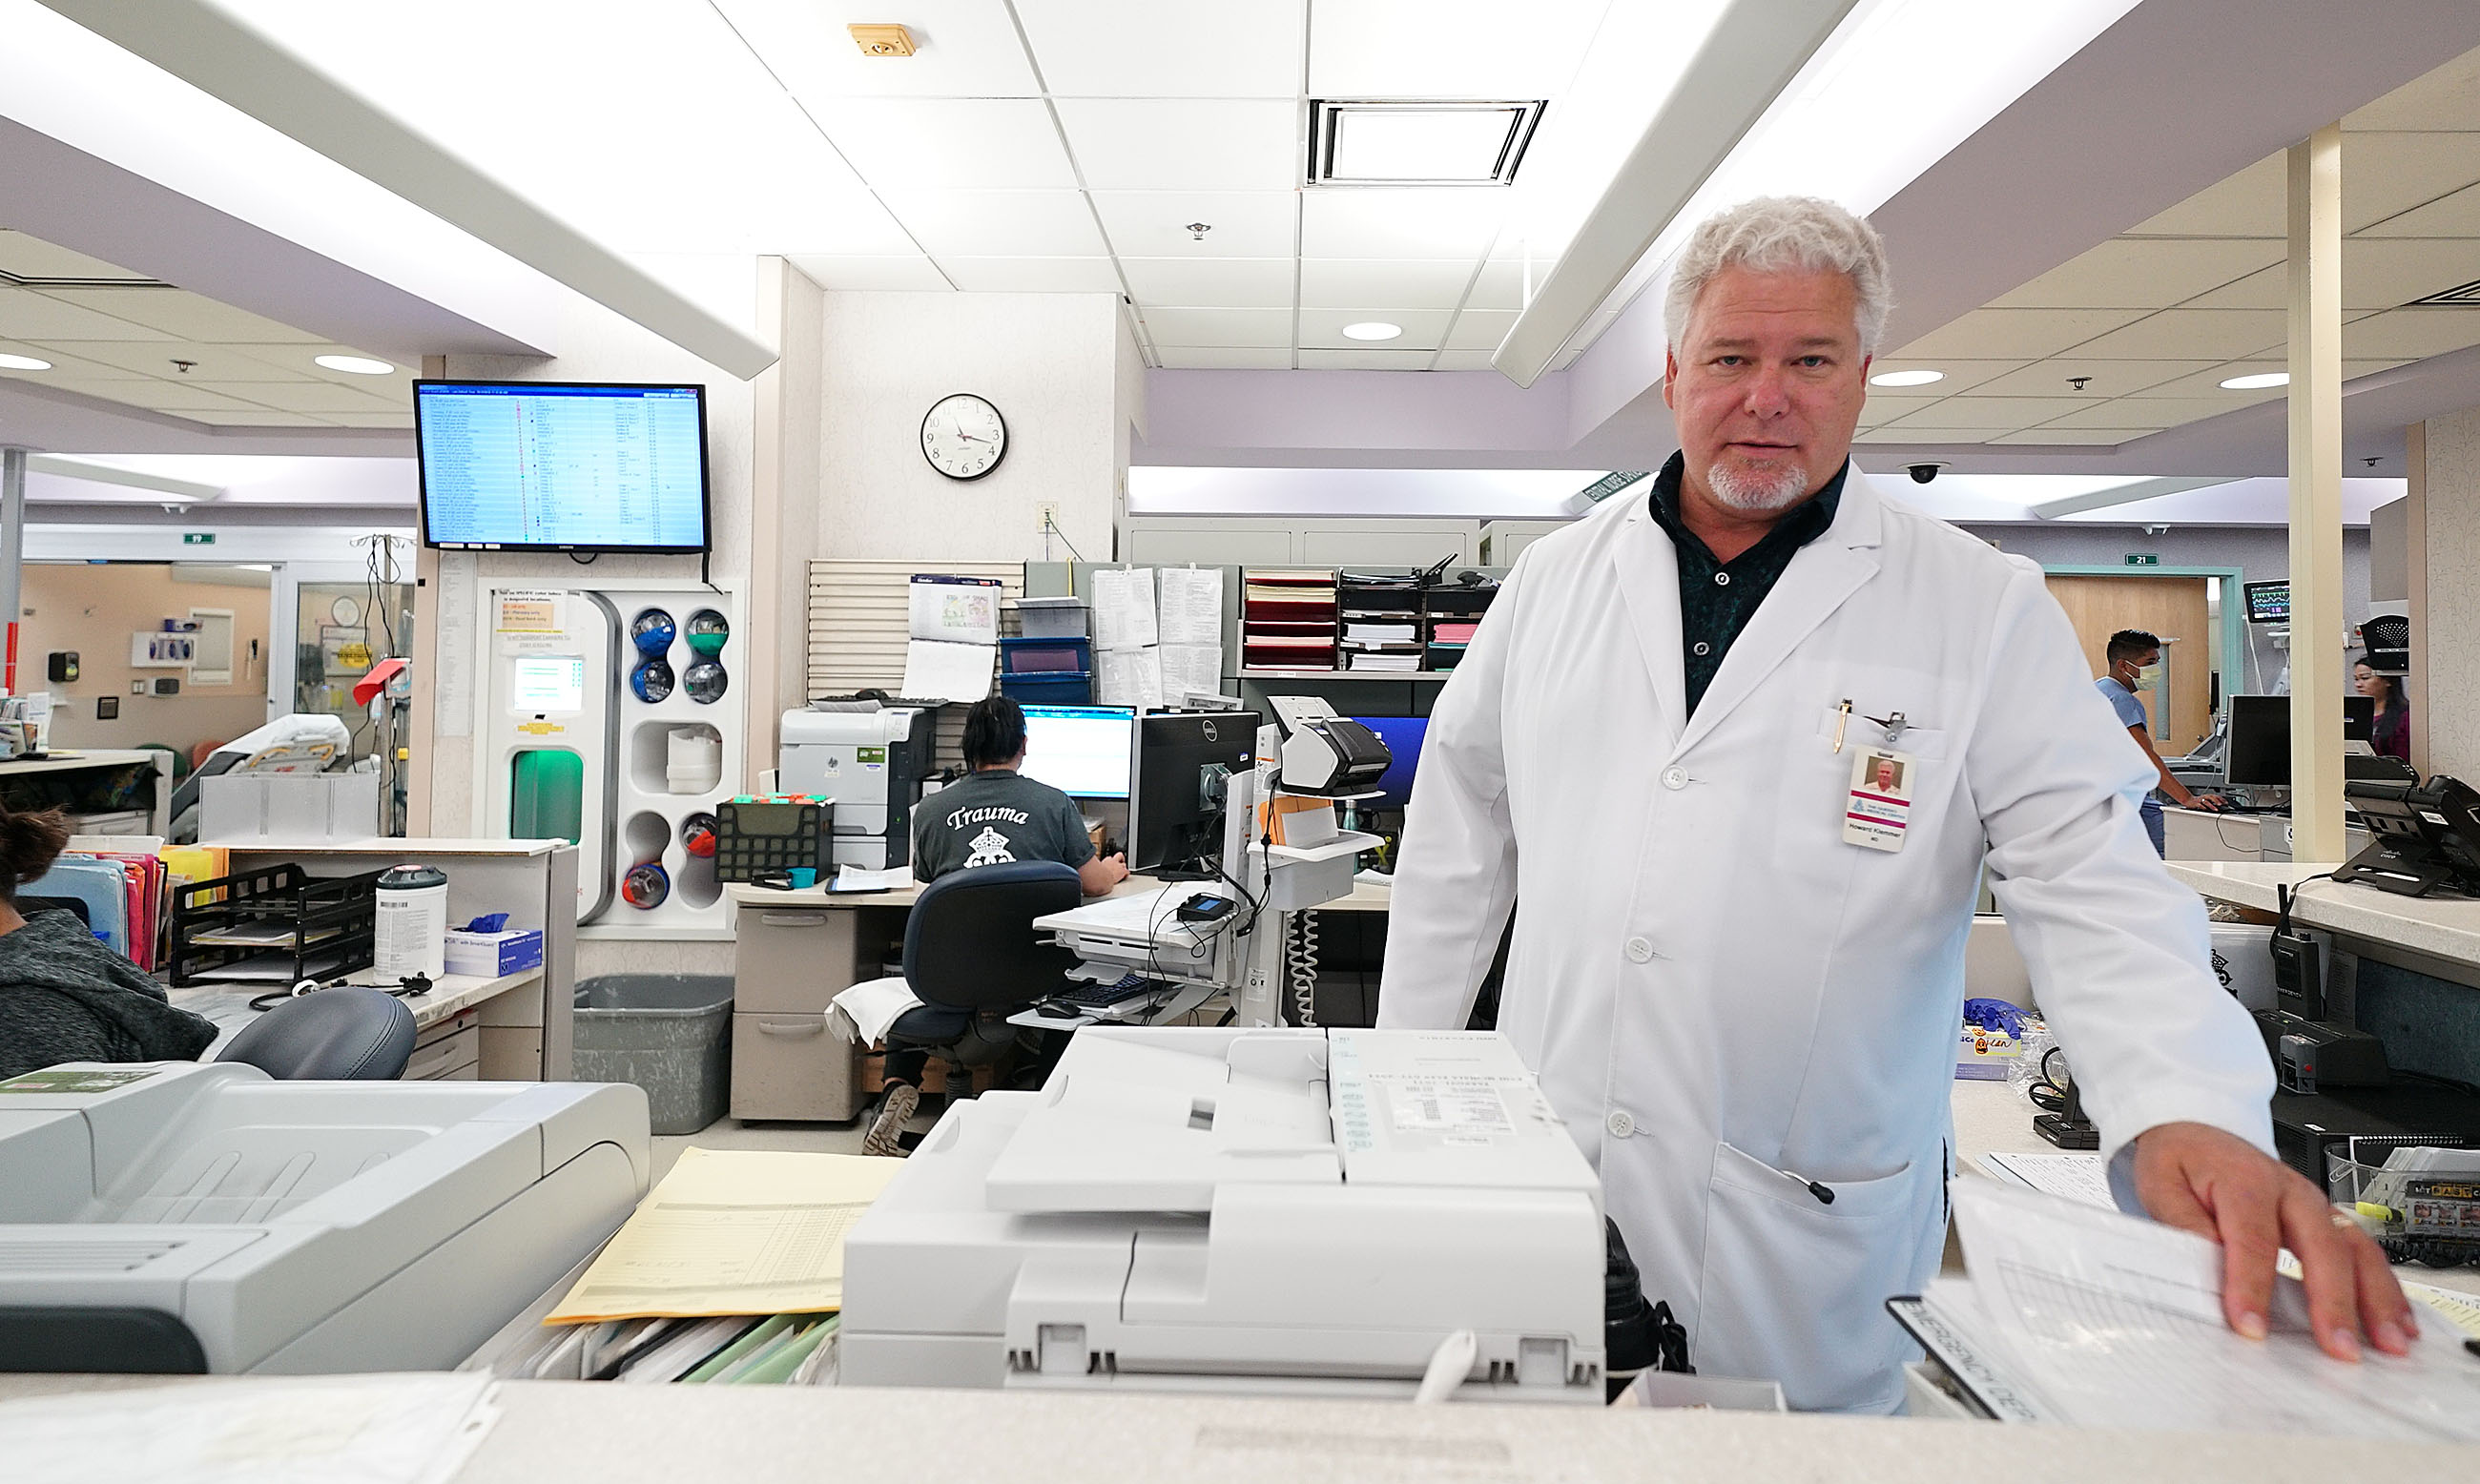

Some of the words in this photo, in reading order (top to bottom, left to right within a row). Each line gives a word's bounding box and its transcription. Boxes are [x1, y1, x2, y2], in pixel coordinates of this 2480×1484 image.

[929, 417, 940, 428] 10
[986, 414, 994, 425] 2
[926, 433, 934, 444] 9
[992, 429, 1000, 441] 3
[932, 447, 940, 459] 8
[988, 445, 996, 457] 4
[946, 460, 953, 471] 7
[961, 463, 969, 474] 6
[977, 458, 984, 469] 5
[946, 806, 1030, 831] Trauma
